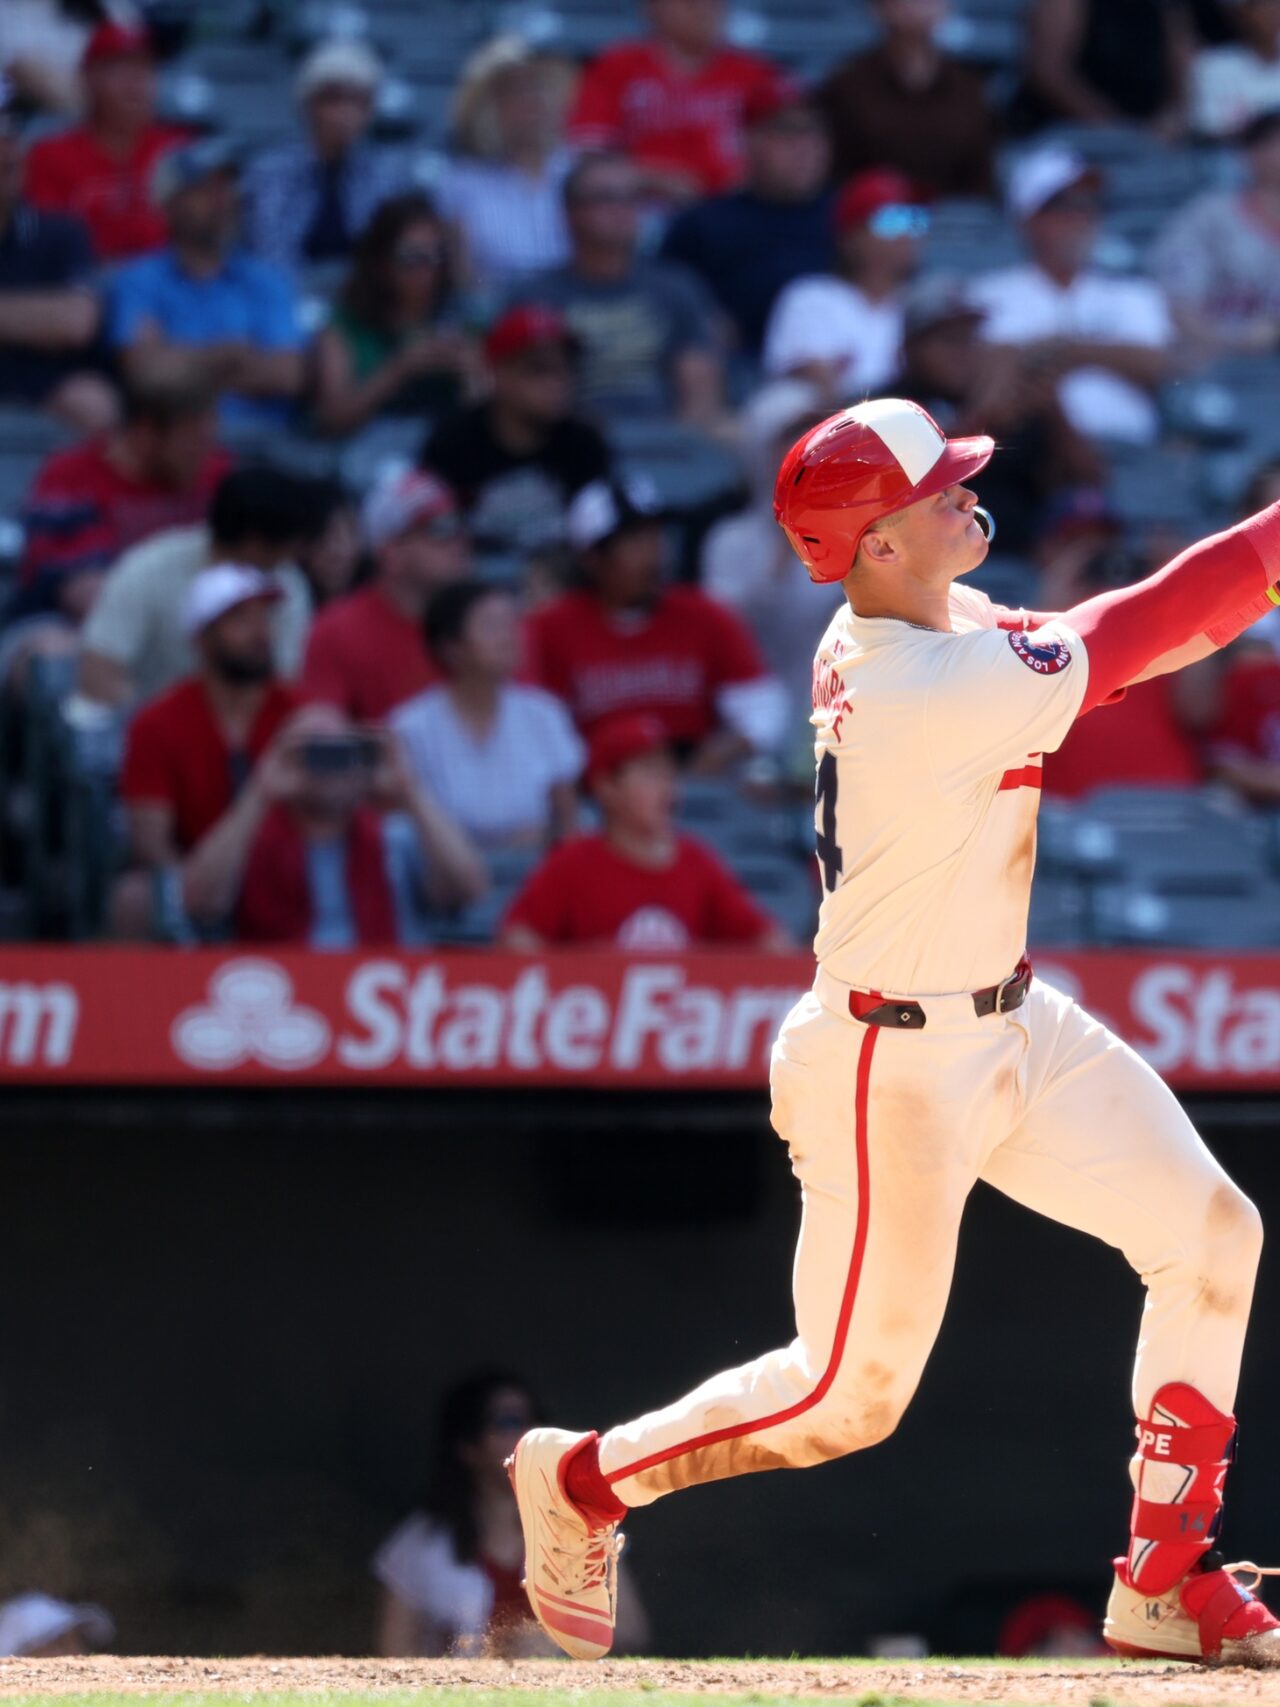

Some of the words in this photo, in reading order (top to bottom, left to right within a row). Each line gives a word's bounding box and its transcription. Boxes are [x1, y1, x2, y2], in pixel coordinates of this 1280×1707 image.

[1027, 655, 1049, 672] LOS
[1135, 1424, 1172, 1456] PE
[1179, 1512, 1206, 1533] 14
[1145, 1602, 1160, 1621] 14
